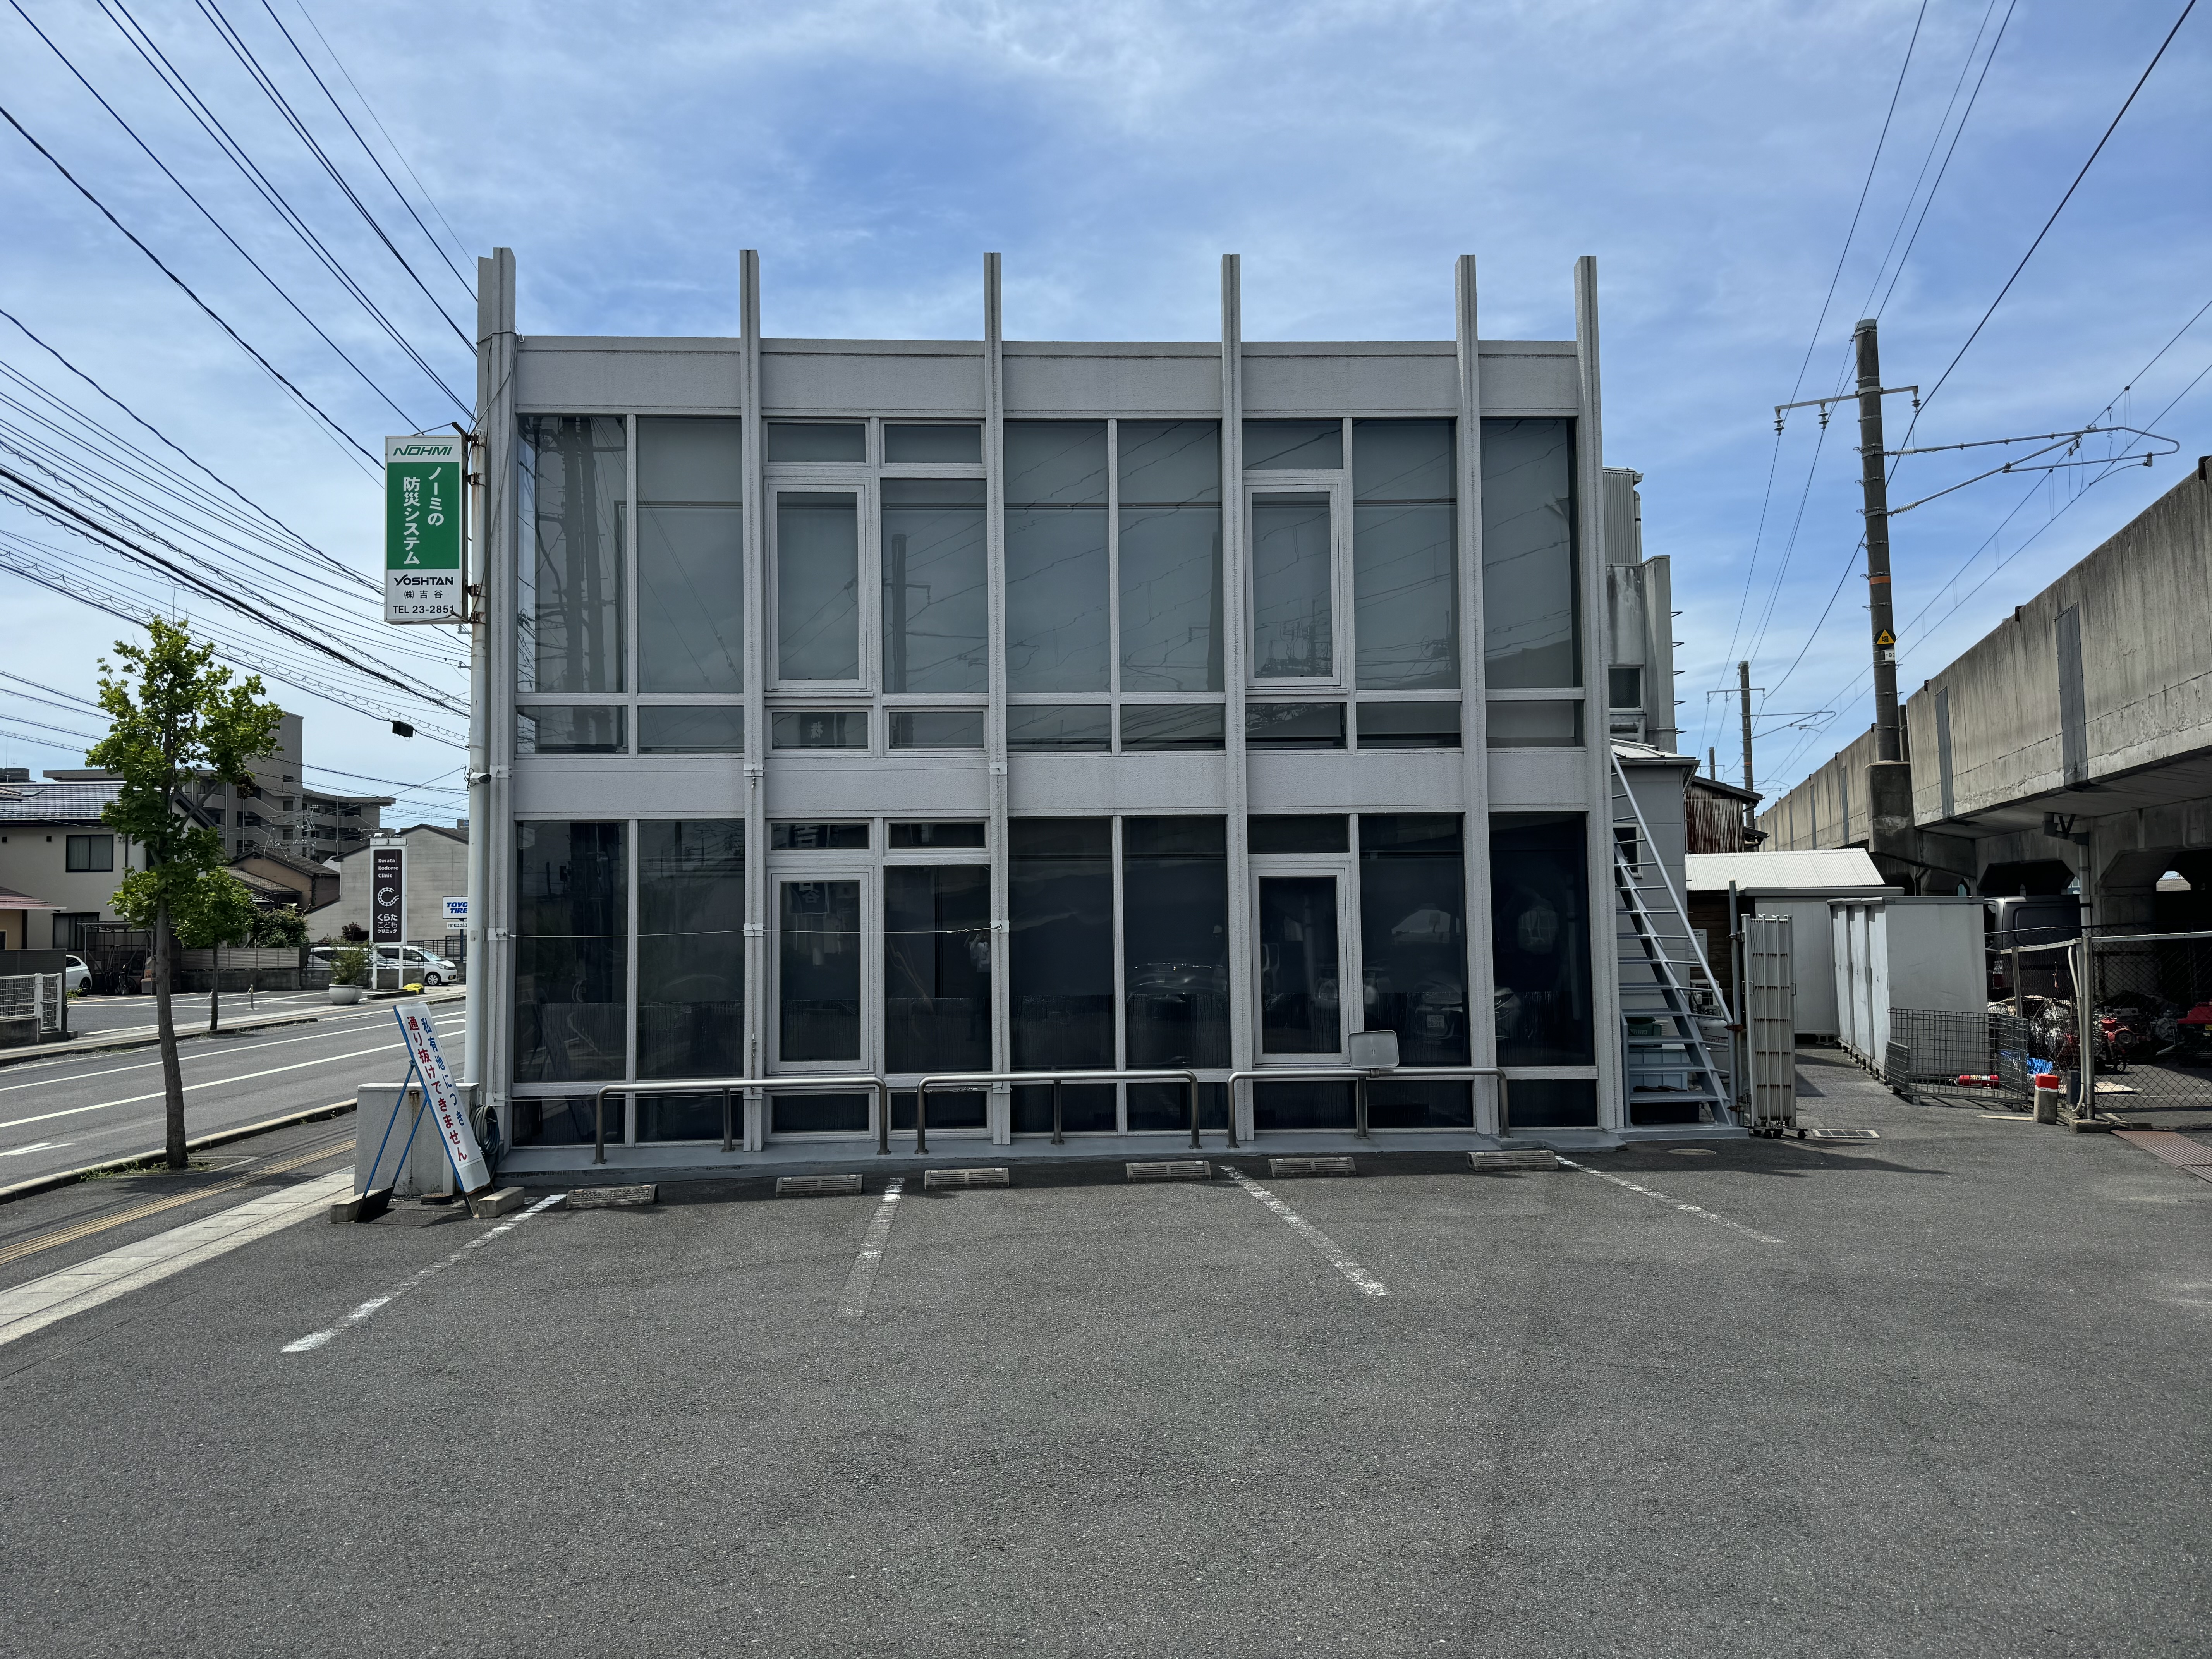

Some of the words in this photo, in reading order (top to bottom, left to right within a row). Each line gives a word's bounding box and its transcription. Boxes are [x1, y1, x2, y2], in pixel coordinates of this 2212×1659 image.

[393, 445, 453, 456] NOHMI
[403, 477, 421, 564] 防災システム
[428, 467, 444, 526] ノーミの
[394, 574, 453, 586] YOSHTAN
[412, 605, 453, 613] 23-2851
[407, 1016, 467, 1161] 通り抜けできません
[421, 1018, 464, 1126] 私有地につき
